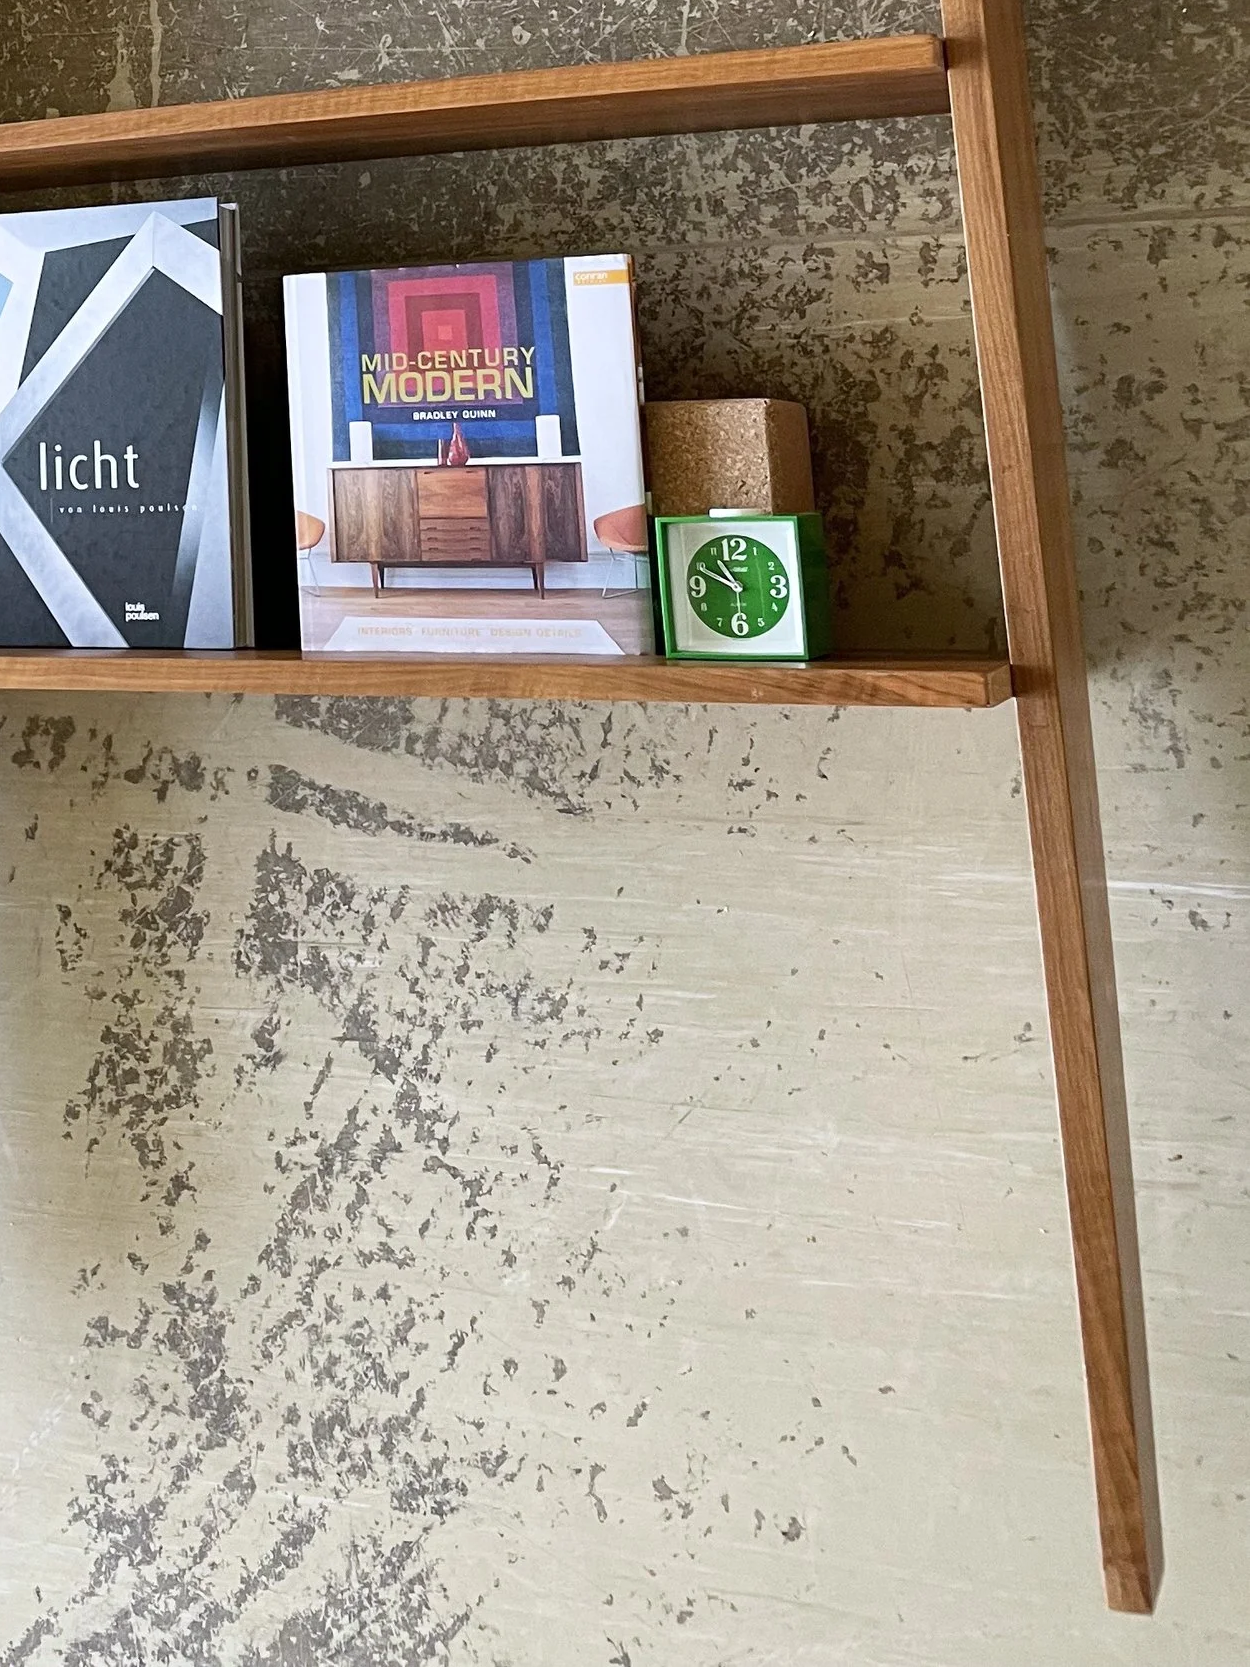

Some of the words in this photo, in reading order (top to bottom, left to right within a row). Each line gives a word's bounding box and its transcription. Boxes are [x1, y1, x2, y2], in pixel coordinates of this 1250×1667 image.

[361, 346, 536, 372] MID-CENTURY
[362, 366, 535, 405] MODERN
[412, 410, 459, 421] BRADLEY
[462, 409, 497, 419] QUINN
[39, 439, 140, 491] licht
[58, 506, 83, 514] von
[92, 504, 129, 514] louis
[721, 538, 747, 562] 12
[753, 547, 757, 556] 1
[767, 562, 774, 571] 2
[689, 576, 706, 598] 9
[769, 575, 787, 599] 3
[125, 601, 146, 612] louis
[700, 603, 707, 612] 8
[771, 603, 777, 612] 4
[716, 618, 722, 627] 7
[731, 613, 748, 636] 6
[757, 618, 764, 627] 5
